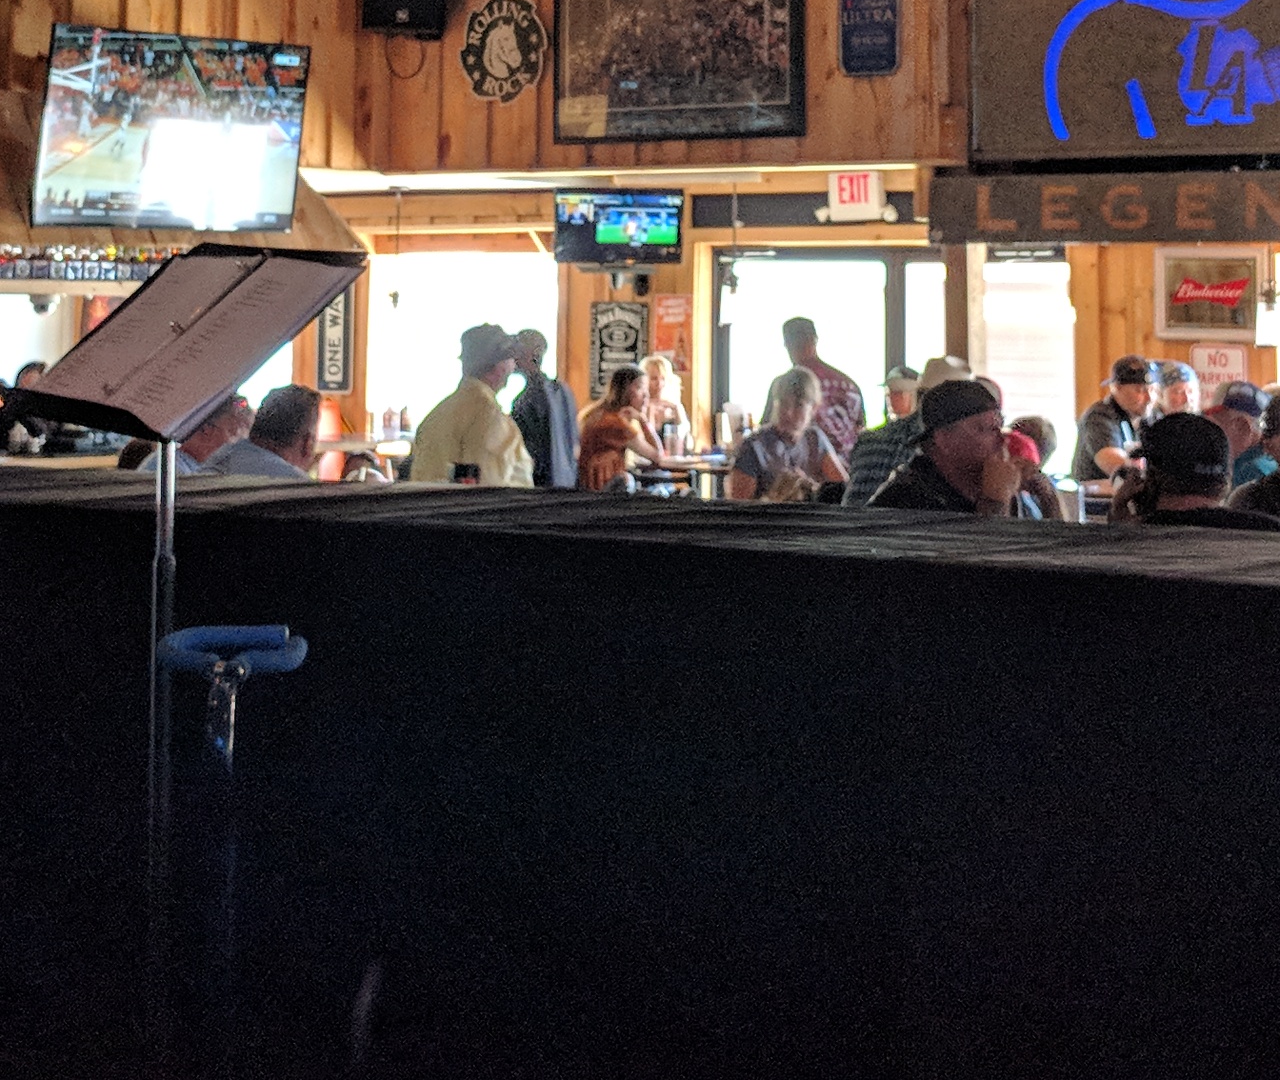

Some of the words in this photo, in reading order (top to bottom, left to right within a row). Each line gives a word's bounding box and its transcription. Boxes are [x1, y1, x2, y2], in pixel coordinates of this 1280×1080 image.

[468, 0, 530, 46] ROLLING
[482, 68, 532, 97] ROCK
[837, 172, 869, 204] EXIT
[1177, 282, 1243, 298] Budweiser
[328, 298, 343, 329] WA
[327, 338, 341, 376] ONE
[1207, 352, 1228, 368] NO
[1197, 372, 1242, 385] ARKING
